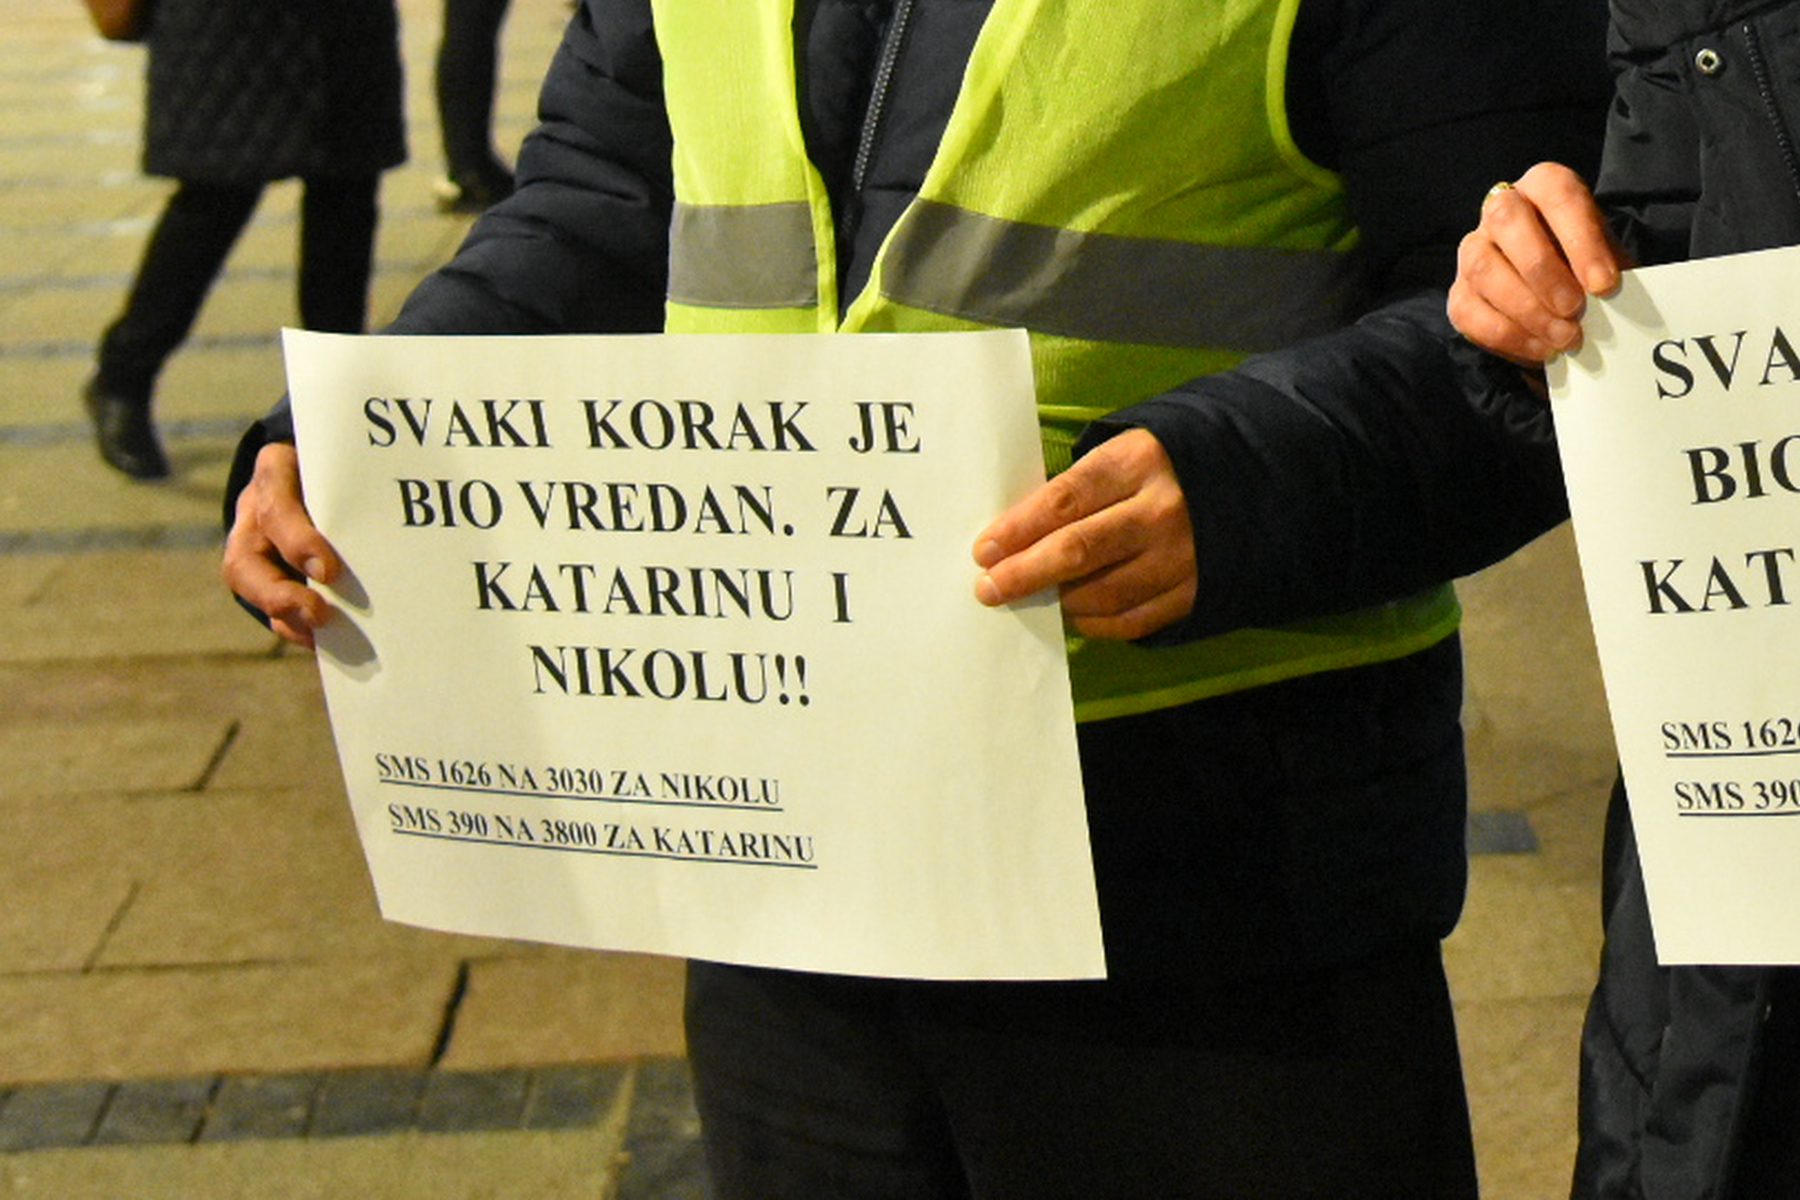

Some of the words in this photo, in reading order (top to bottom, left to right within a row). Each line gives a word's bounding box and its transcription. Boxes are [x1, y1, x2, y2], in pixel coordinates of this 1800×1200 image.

[362, 396, 551, 448] SVAKI
[580, 399, 818, 452] KORAK
[848, 401, 921, 454] JE
[396, 478, 503, 530] BIO
[516, 480, 795, 537] VREDAN.
[826, 486, 914, 540] ZA
[472, 561, 796, 622] KATARINU
[831, 572, 853, 624] I
[528, 645, 811, 707] NIKOLU!!
[1661, 721, 1733, 751] SMS
[375, 753, 431, 781] SMS
[438, 758, 492, 788] 1626
[498, 763, 539, 791] NA
[546, 766, 604, 795] 3030
[610, 770, 653, 799] ZA
[660, 772, 781, 805] NIKOLU
[1674, 781, 1745, 810] SMS
[388, 804, 442, 832] SMS
[448, 810, 488, 838] 390
[494, 814, 535, 843] NA
[541, 818, 598, 847] 3800
[604, 824, 647, 851] ZA
[652, 827, 815, 863] KATARINU
